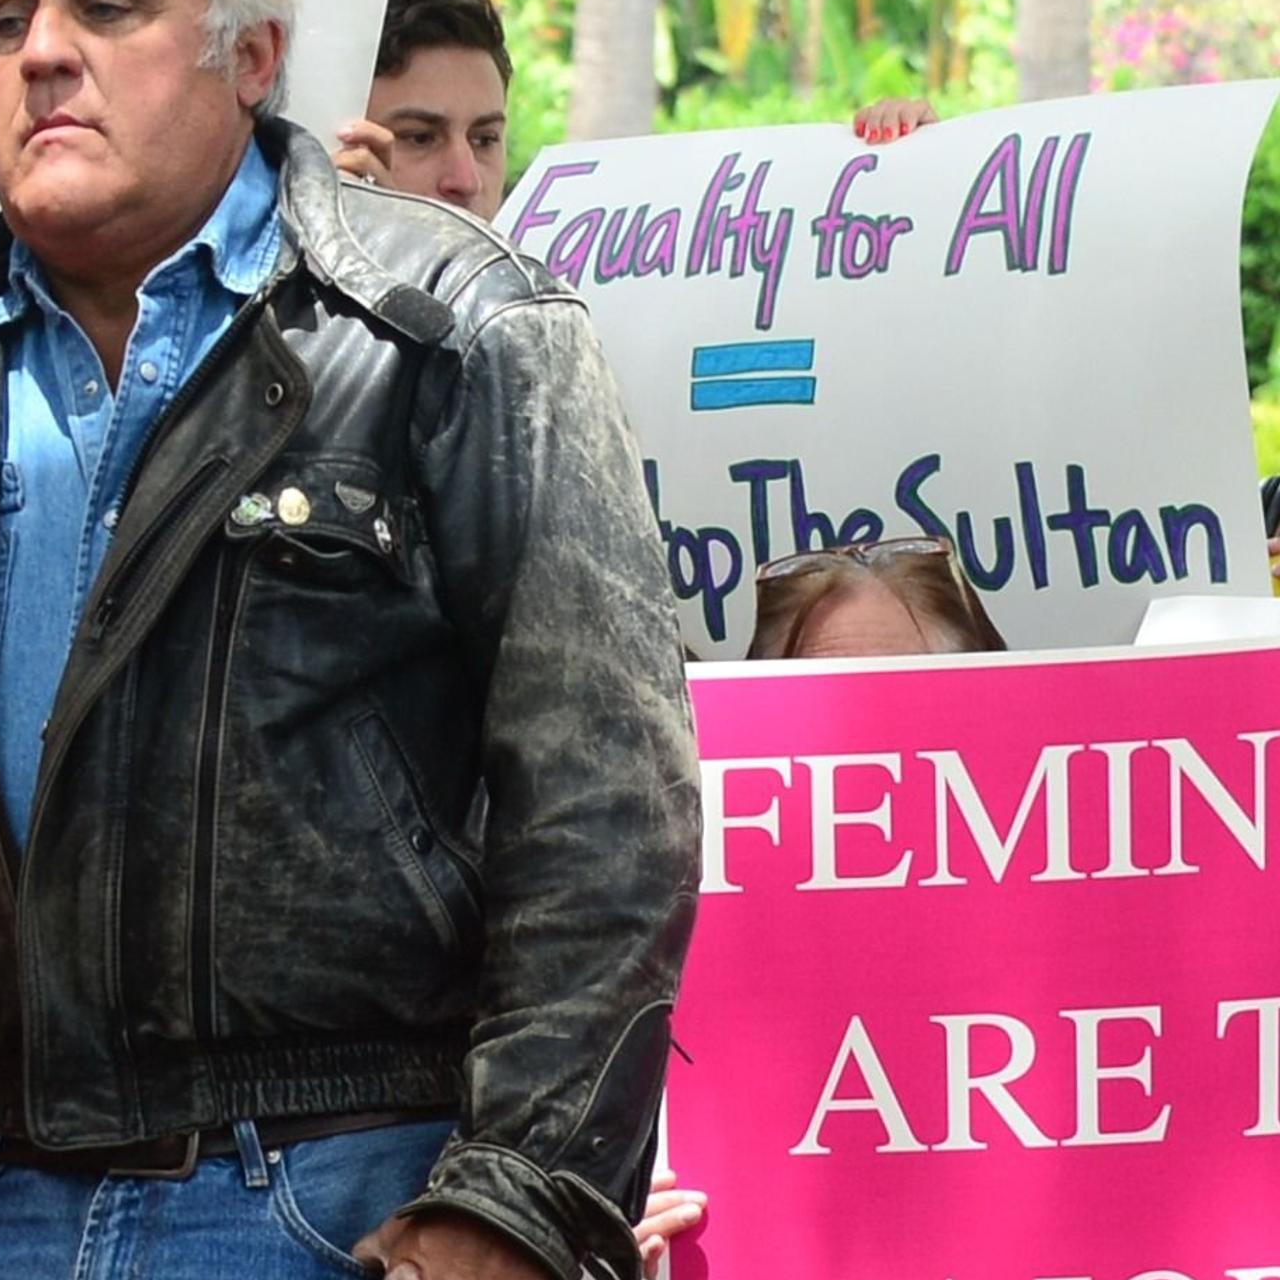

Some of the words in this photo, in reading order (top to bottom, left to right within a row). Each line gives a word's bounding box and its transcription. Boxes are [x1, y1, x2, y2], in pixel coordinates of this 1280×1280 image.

[506, 151, 794, 330] Equality
[812, 154, 913, 280] for
[945, 131, 1091, 276] All
[700, 729, 1280, 895] FEMIN
[789, 1004, 1172, 1157] ARE
